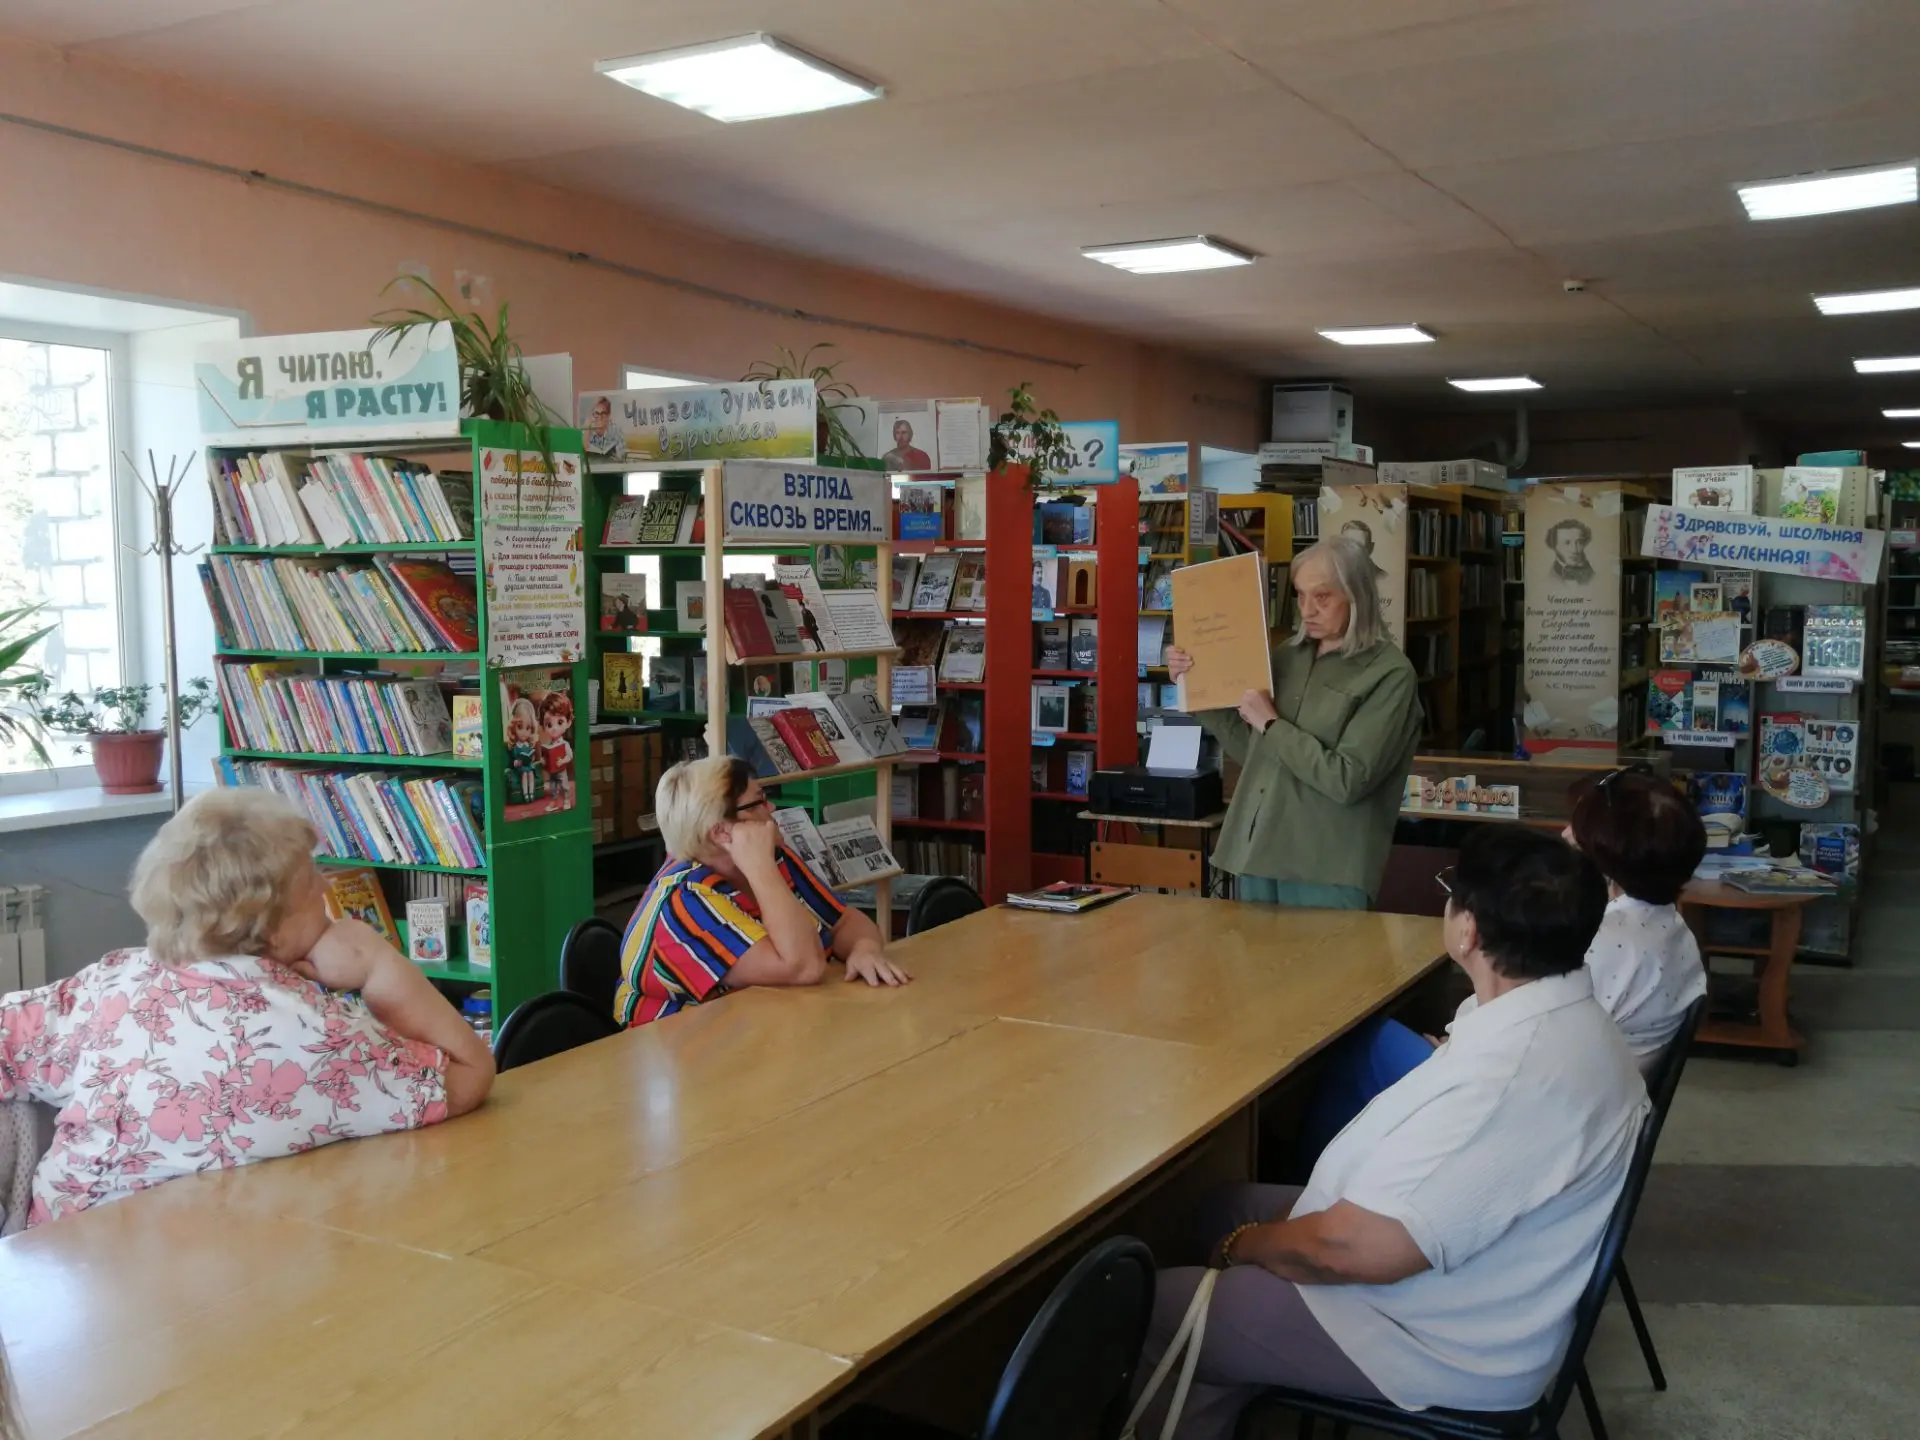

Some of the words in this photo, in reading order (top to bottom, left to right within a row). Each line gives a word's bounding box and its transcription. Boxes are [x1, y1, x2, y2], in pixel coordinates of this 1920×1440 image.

[237, 357, 262, 399] Я
[278, 351, 382, 382] ЧИТАЮ,
[306, 390, 326, 419] Я
[337, 381, 446, 418] РАСТУ!
[624, 399, 712, 427] Читаем,
[720, 386, 813, 426] думаем,
[784, 473, 853, 500] ВЗГЛЯД
[730, 501, 807, 529] СКВОЗЬ
[813, 507, 883, 533] ВРЕМЯ...
[1673, 513, 1771, 537] ЗДРАВСТВУЙ,
[1779, 526, 1864, 544] ШКОЛЬНАЯ
[1708, 543, 1811, 565] ВСЕЛЕННАЯ!
[1807, 723, 1854, 743] ЧТО
